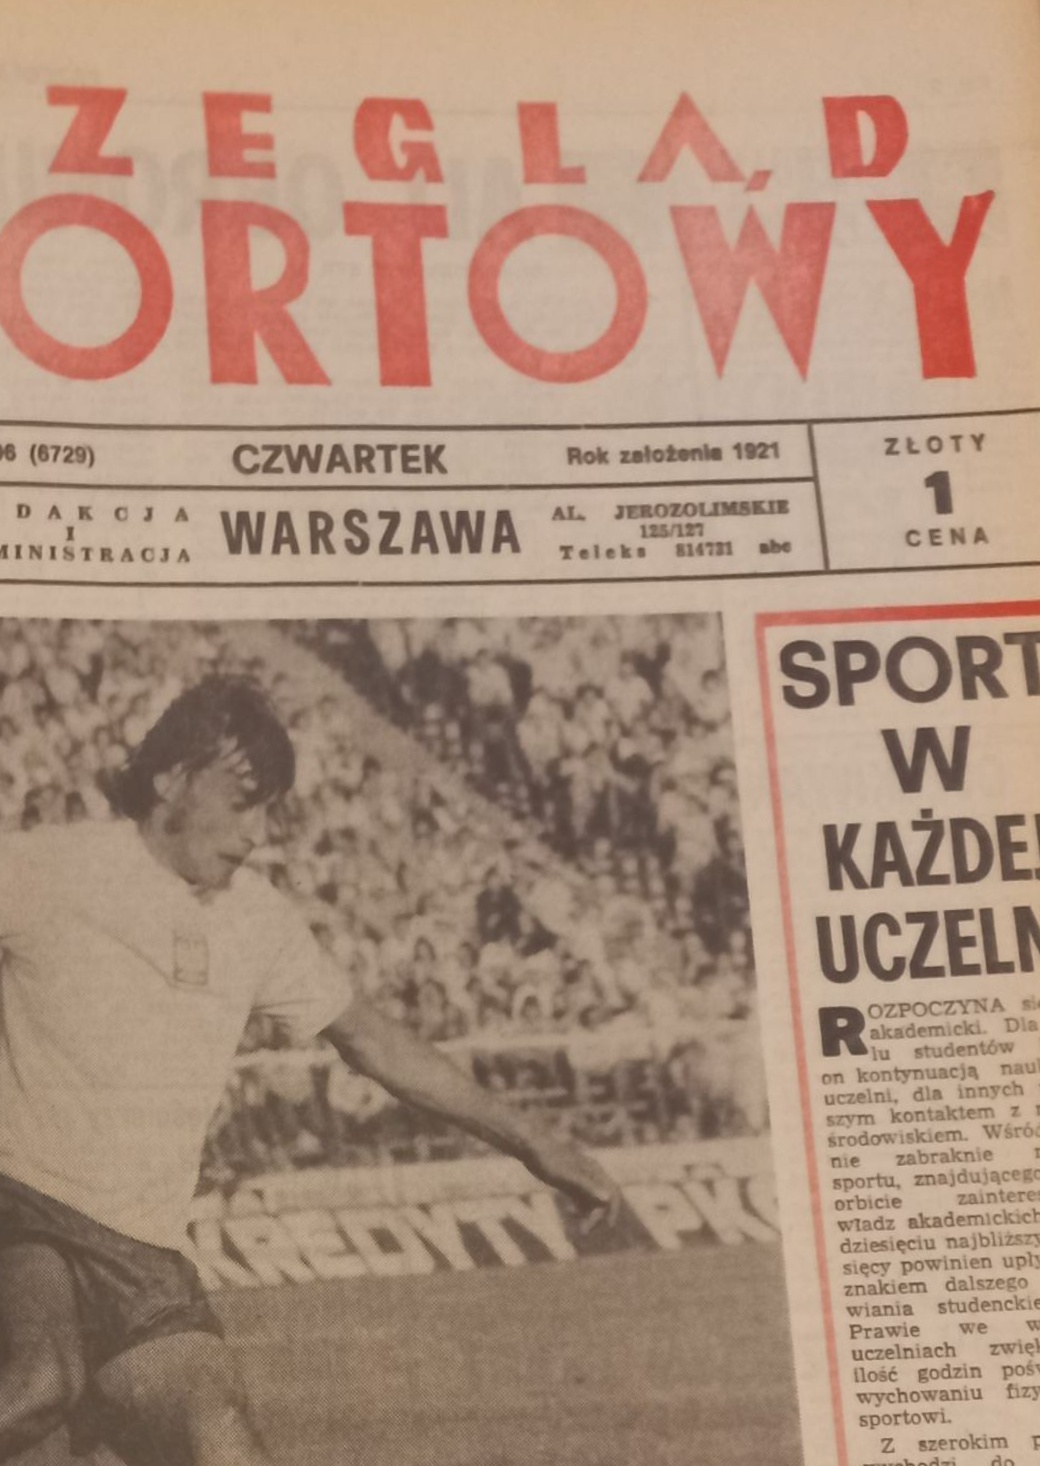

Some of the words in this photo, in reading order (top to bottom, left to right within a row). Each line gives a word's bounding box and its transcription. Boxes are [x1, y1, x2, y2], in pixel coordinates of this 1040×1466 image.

[567, 447, 609, 465] Rok
[620, 444, 722, 464] założenia
[733, 442, 779, 460] 1921
[884, 433, 985, 455] ZŁOTY
[30, 444, 95, 468] (6729)
[232, 444, 447, 475] CZWARTEK
[925, 471, 953, 514] 1
[614, 500, 789, 520] JEROZOLIMSKIE
[67, 526, 74, 541] I
[220, 509, 521, 555] WARSZAWA
[640, 523, 704, 538] 125/127
[905, 527, 988, 547] CENA
[559, 544, 646, 560] Teleks
[780, 631, 1040, 709] SPORT
[881, 725, 971, 793] W
[823, 808, 1040, 891] KAŻDE
[913, 1086, 943, 1102] dla
[957, 1080, 1024, 1099] innych
[844, 1279, 928, 1296] znakiem
[945, 1275, 1028, 1292] dalszego
